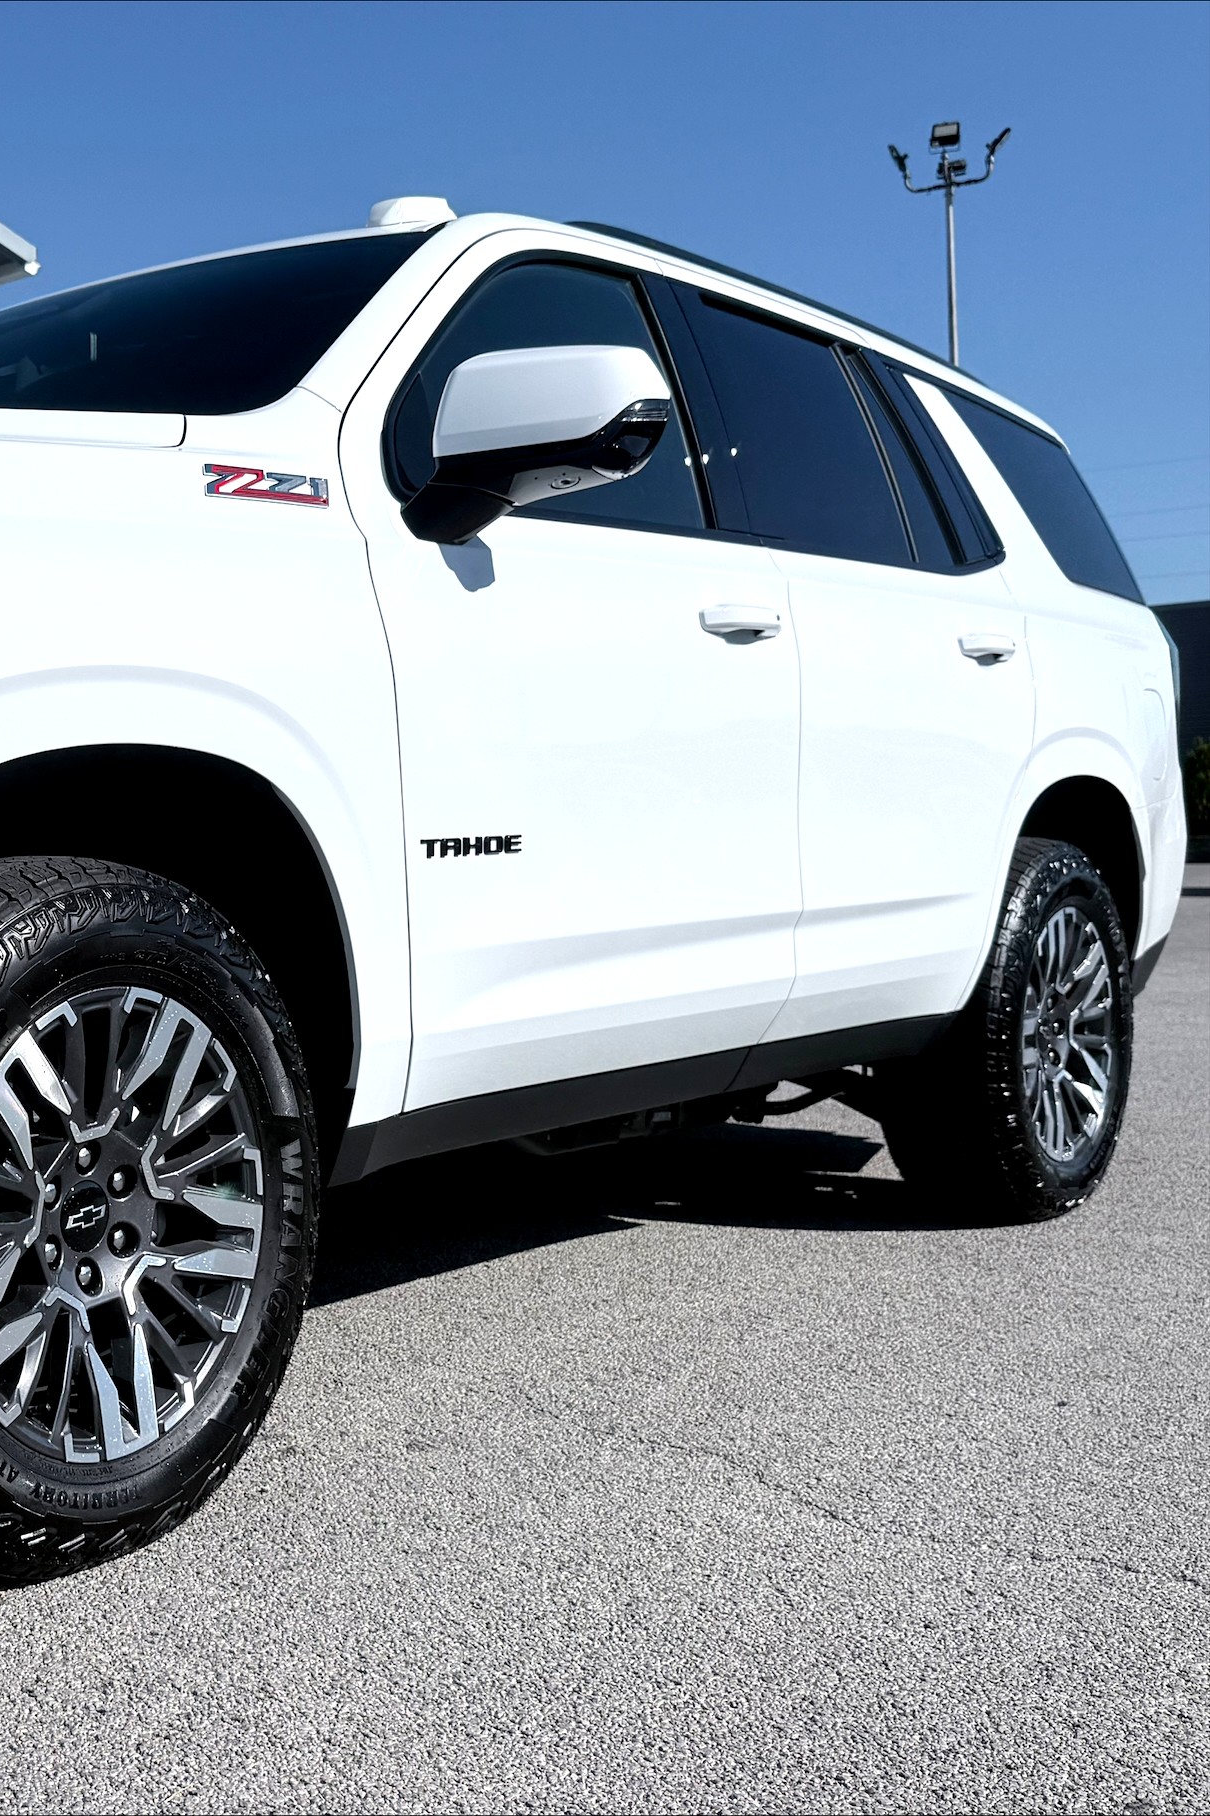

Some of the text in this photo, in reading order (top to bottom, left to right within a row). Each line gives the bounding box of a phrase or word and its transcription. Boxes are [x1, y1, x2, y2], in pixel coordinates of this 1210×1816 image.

[202, 463, 329, 509] Z71
[420, 834, 522, 859] TAHOE
[230, 1138, 304, 1410] WRANGLER
